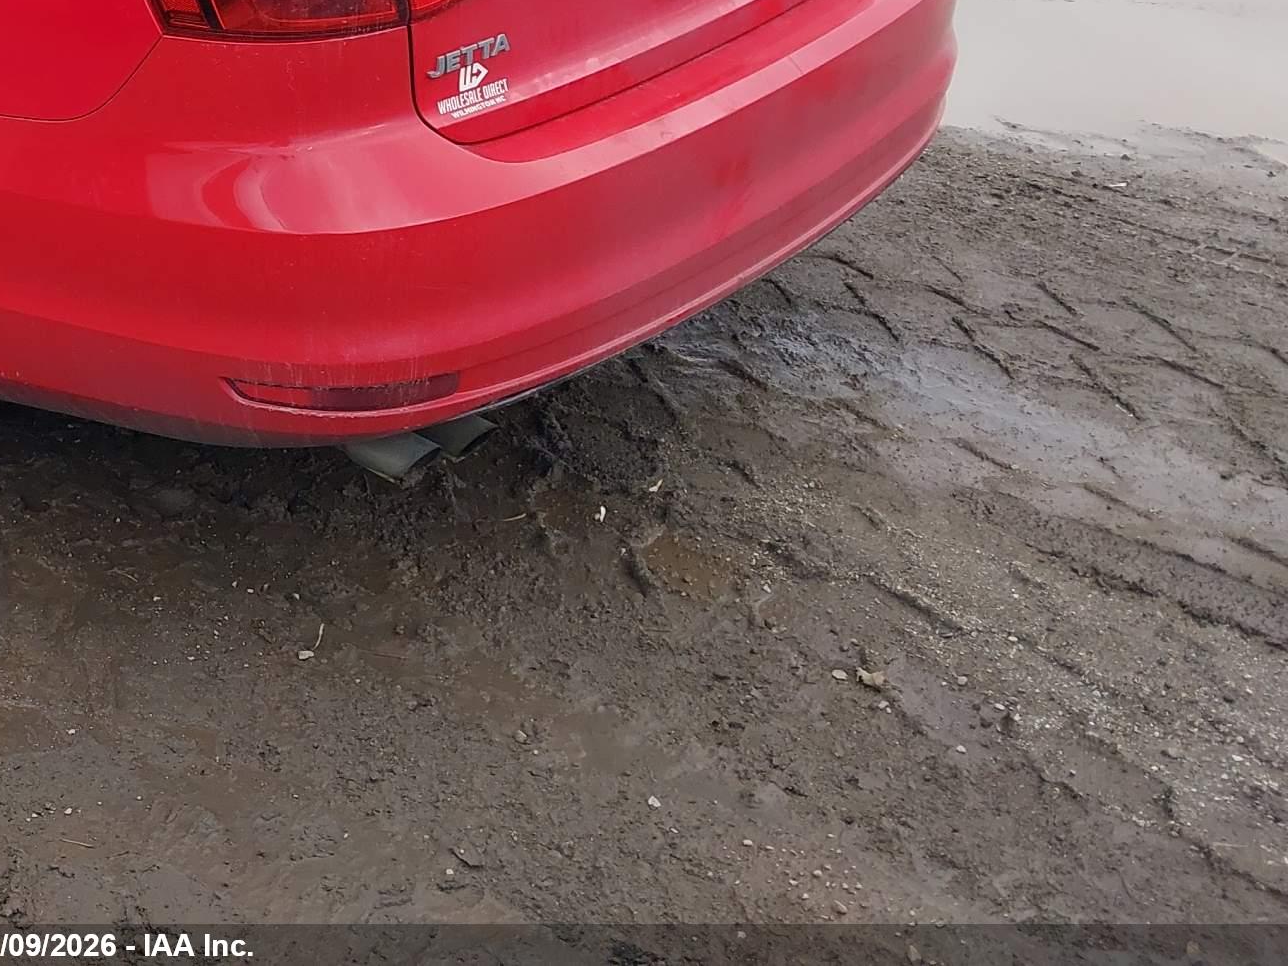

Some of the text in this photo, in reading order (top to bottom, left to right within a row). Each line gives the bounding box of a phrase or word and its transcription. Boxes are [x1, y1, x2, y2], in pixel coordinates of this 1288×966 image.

[426, 33, 511, 79] JETTA
[437, 78, 509, 115] WHOLESALE DIRECT
